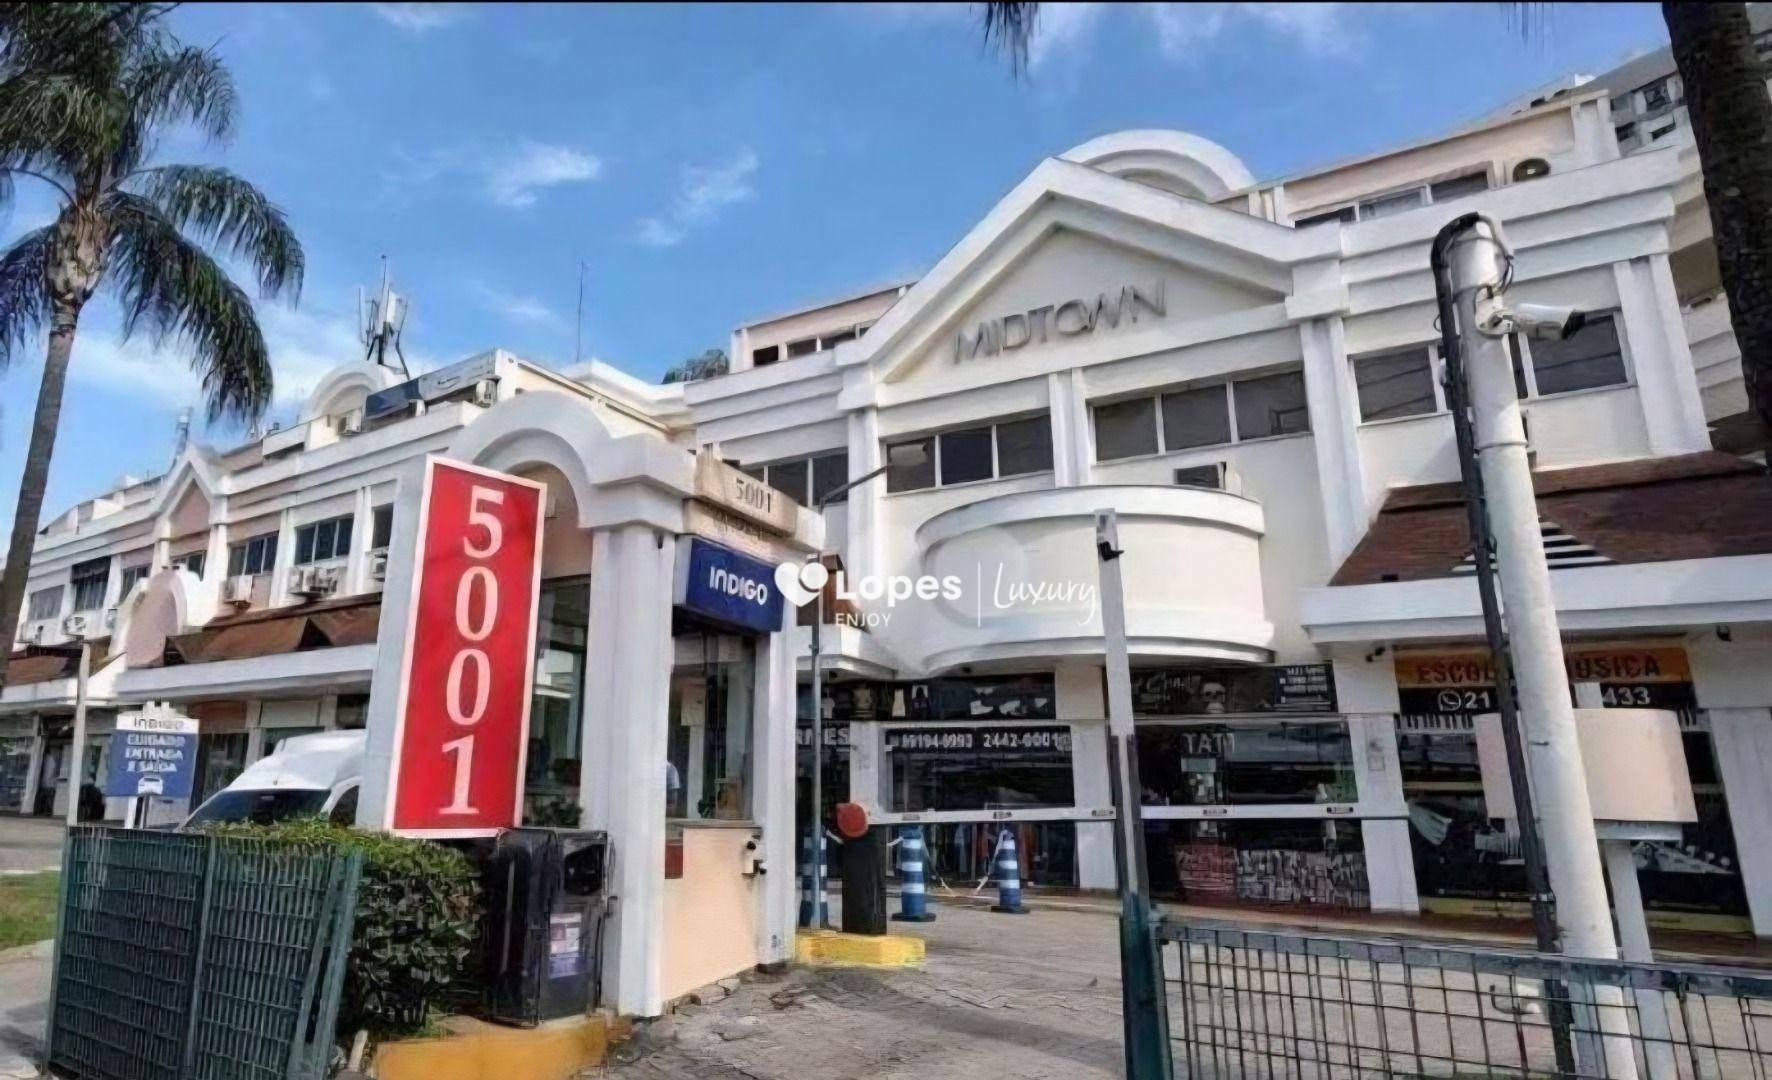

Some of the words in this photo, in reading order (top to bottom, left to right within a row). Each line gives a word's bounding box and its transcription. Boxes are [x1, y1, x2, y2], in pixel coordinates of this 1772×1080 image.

[953, 279, 1166, 364] MIDTOWN
[735, 477, 771, 513] 5001
[709, 565, 768, 606] INDIGO
[439, 484, 505, 816] 5001
